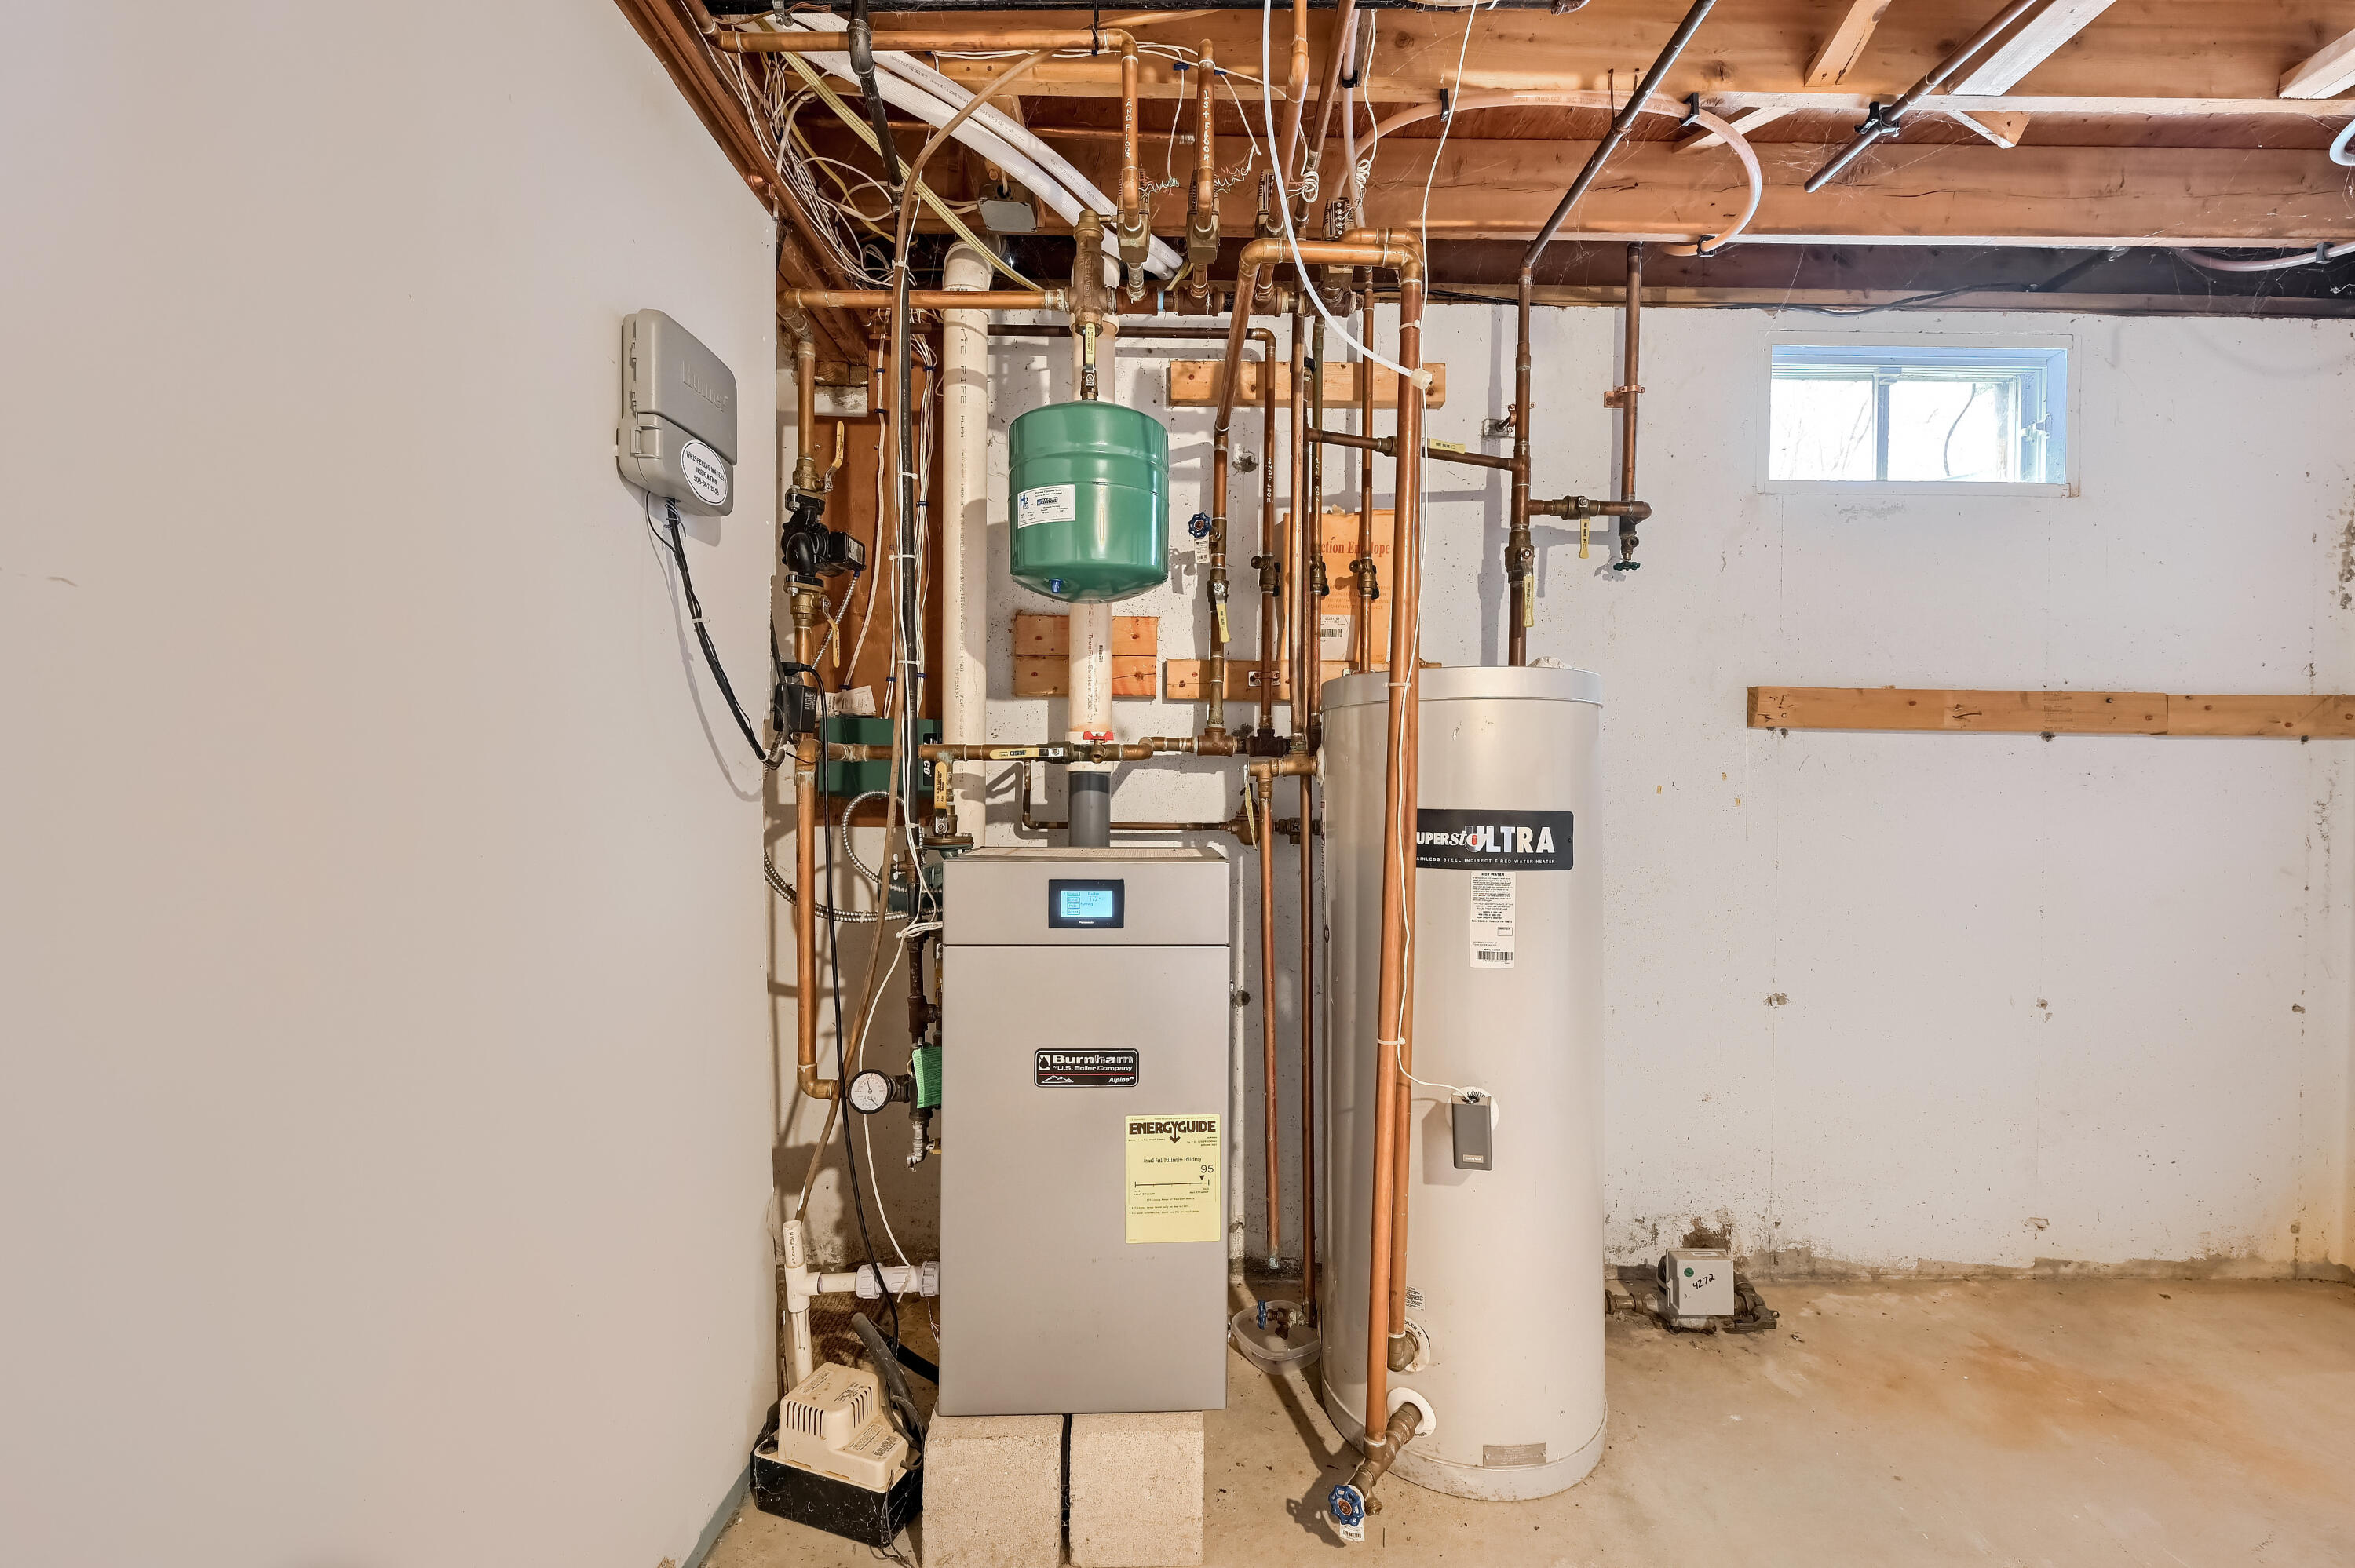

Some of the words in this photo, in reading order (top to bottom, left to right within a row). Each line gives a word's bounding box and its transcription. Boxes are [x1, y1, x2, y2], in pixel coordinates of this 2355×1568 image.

[1053, 1054, 1134, 1064] Burnham
[1129, 1121, 1216, 1135] ENERGYGUIDE
[1200, 1165, 1214, 1173] 95
[1692, 1274, 1715, 1290] 4272
